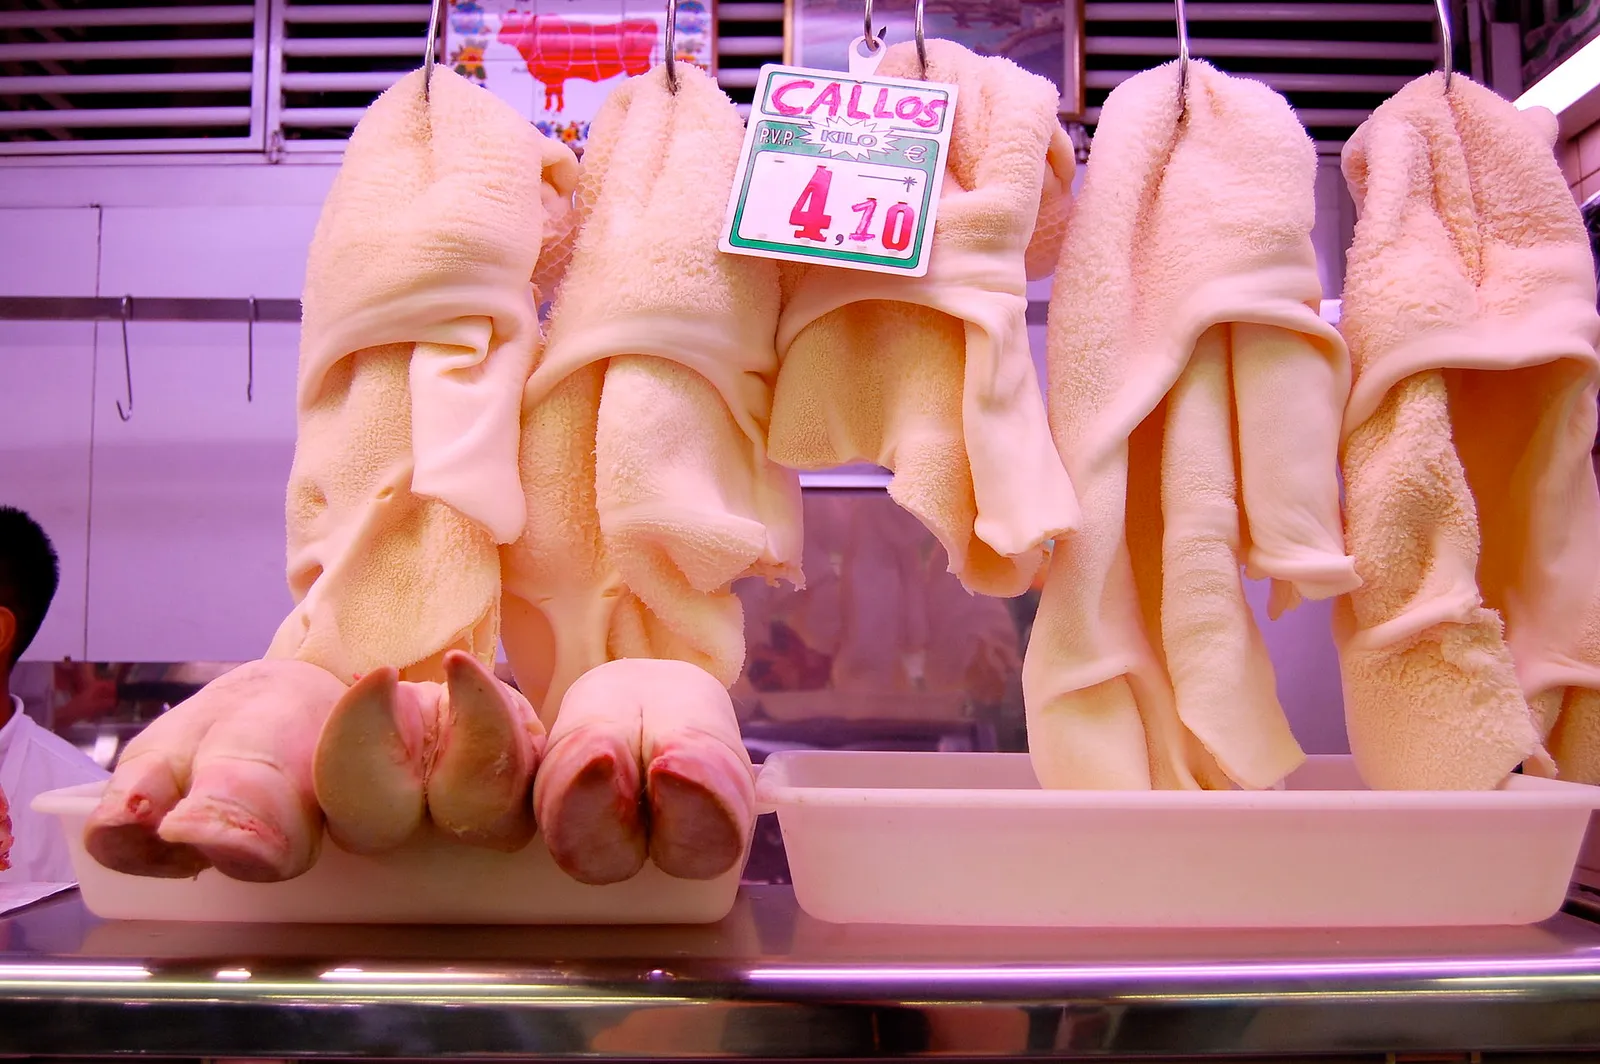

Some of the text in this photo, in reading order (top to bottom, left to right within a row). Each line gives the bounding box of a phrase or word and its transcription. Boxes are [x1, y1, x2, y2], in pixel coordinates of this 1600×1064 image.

[771, 80, 949, 128] CALLOS
[759, 128, 927, 164] P.V.P. KILO €
[788, 165, 915, 252] 4,10
